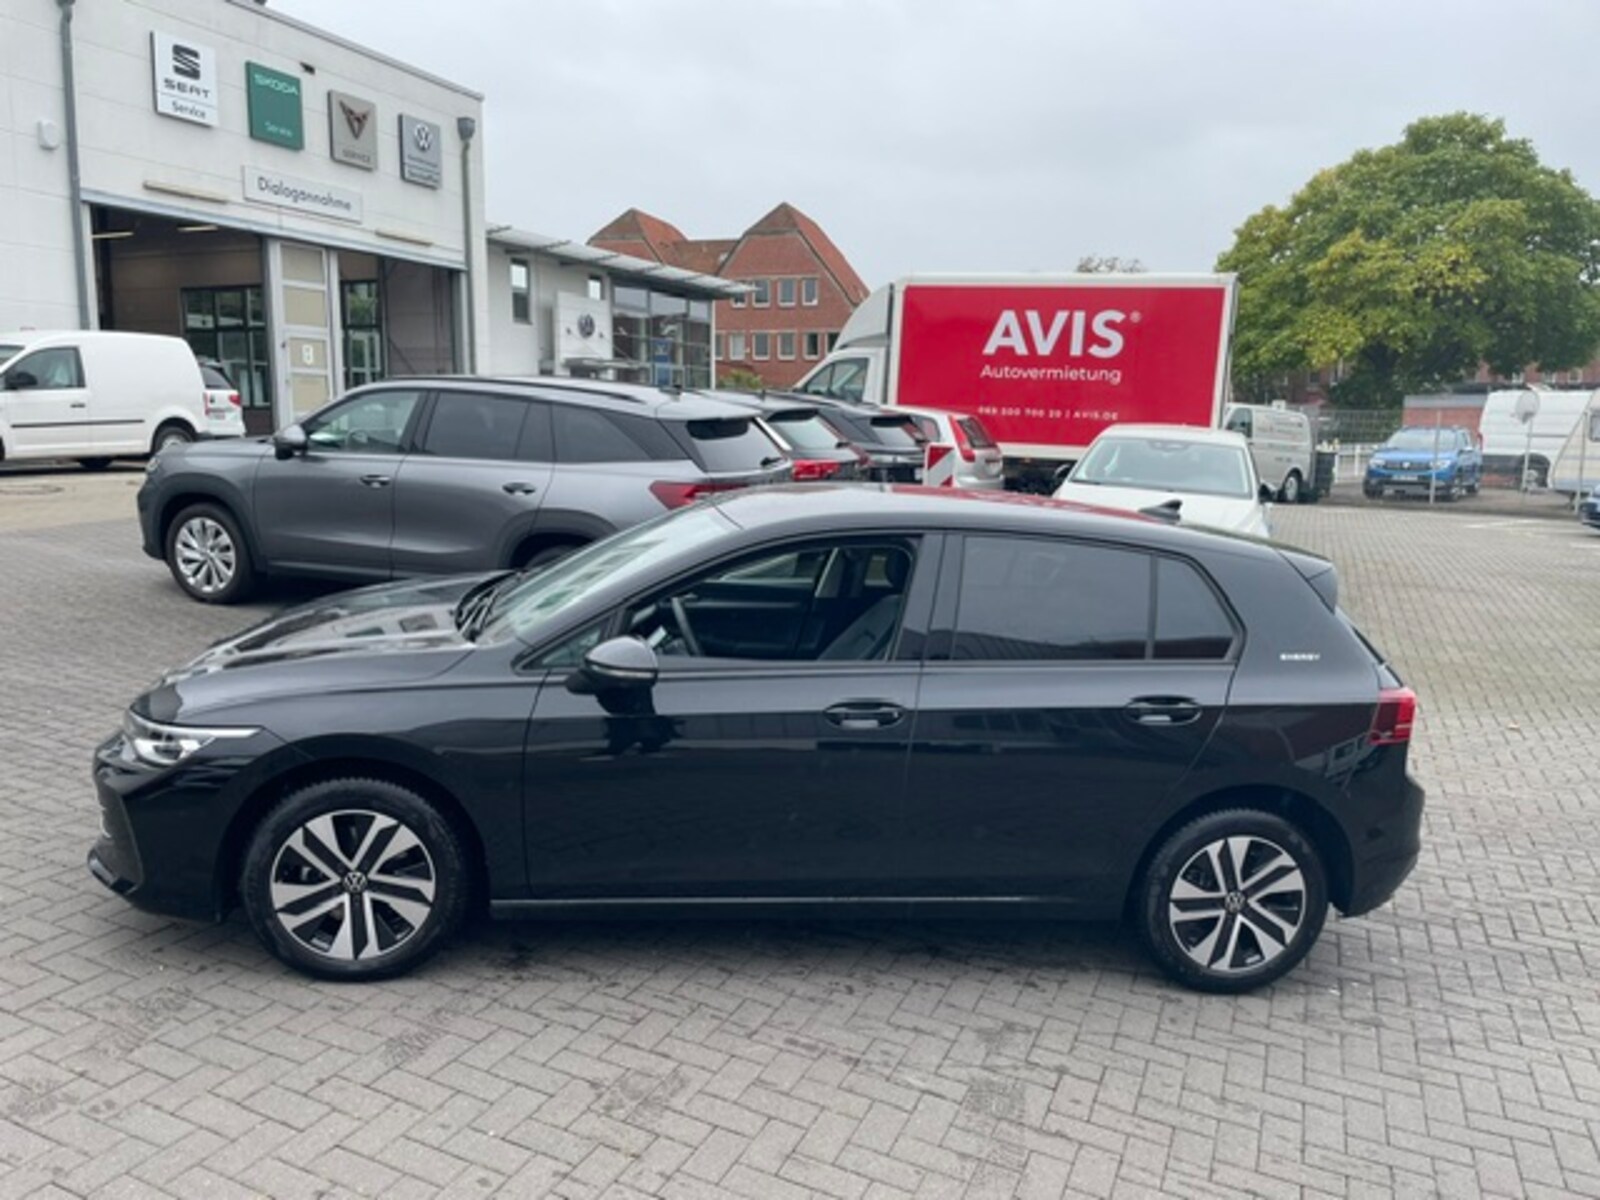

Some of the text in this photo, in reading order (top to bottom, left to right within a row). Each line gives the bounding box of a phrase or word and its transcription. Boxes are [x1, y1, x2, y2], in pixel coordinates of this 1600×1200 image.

[163, 78, 211, 99] SEAT
[172, 101, 207, 119] Service
[257, 176, 352, 211] Dialogannahme
[980, 364, 1122, 386] Autovermietung
[1073, 409, 1119, 421] AVIS.DE
